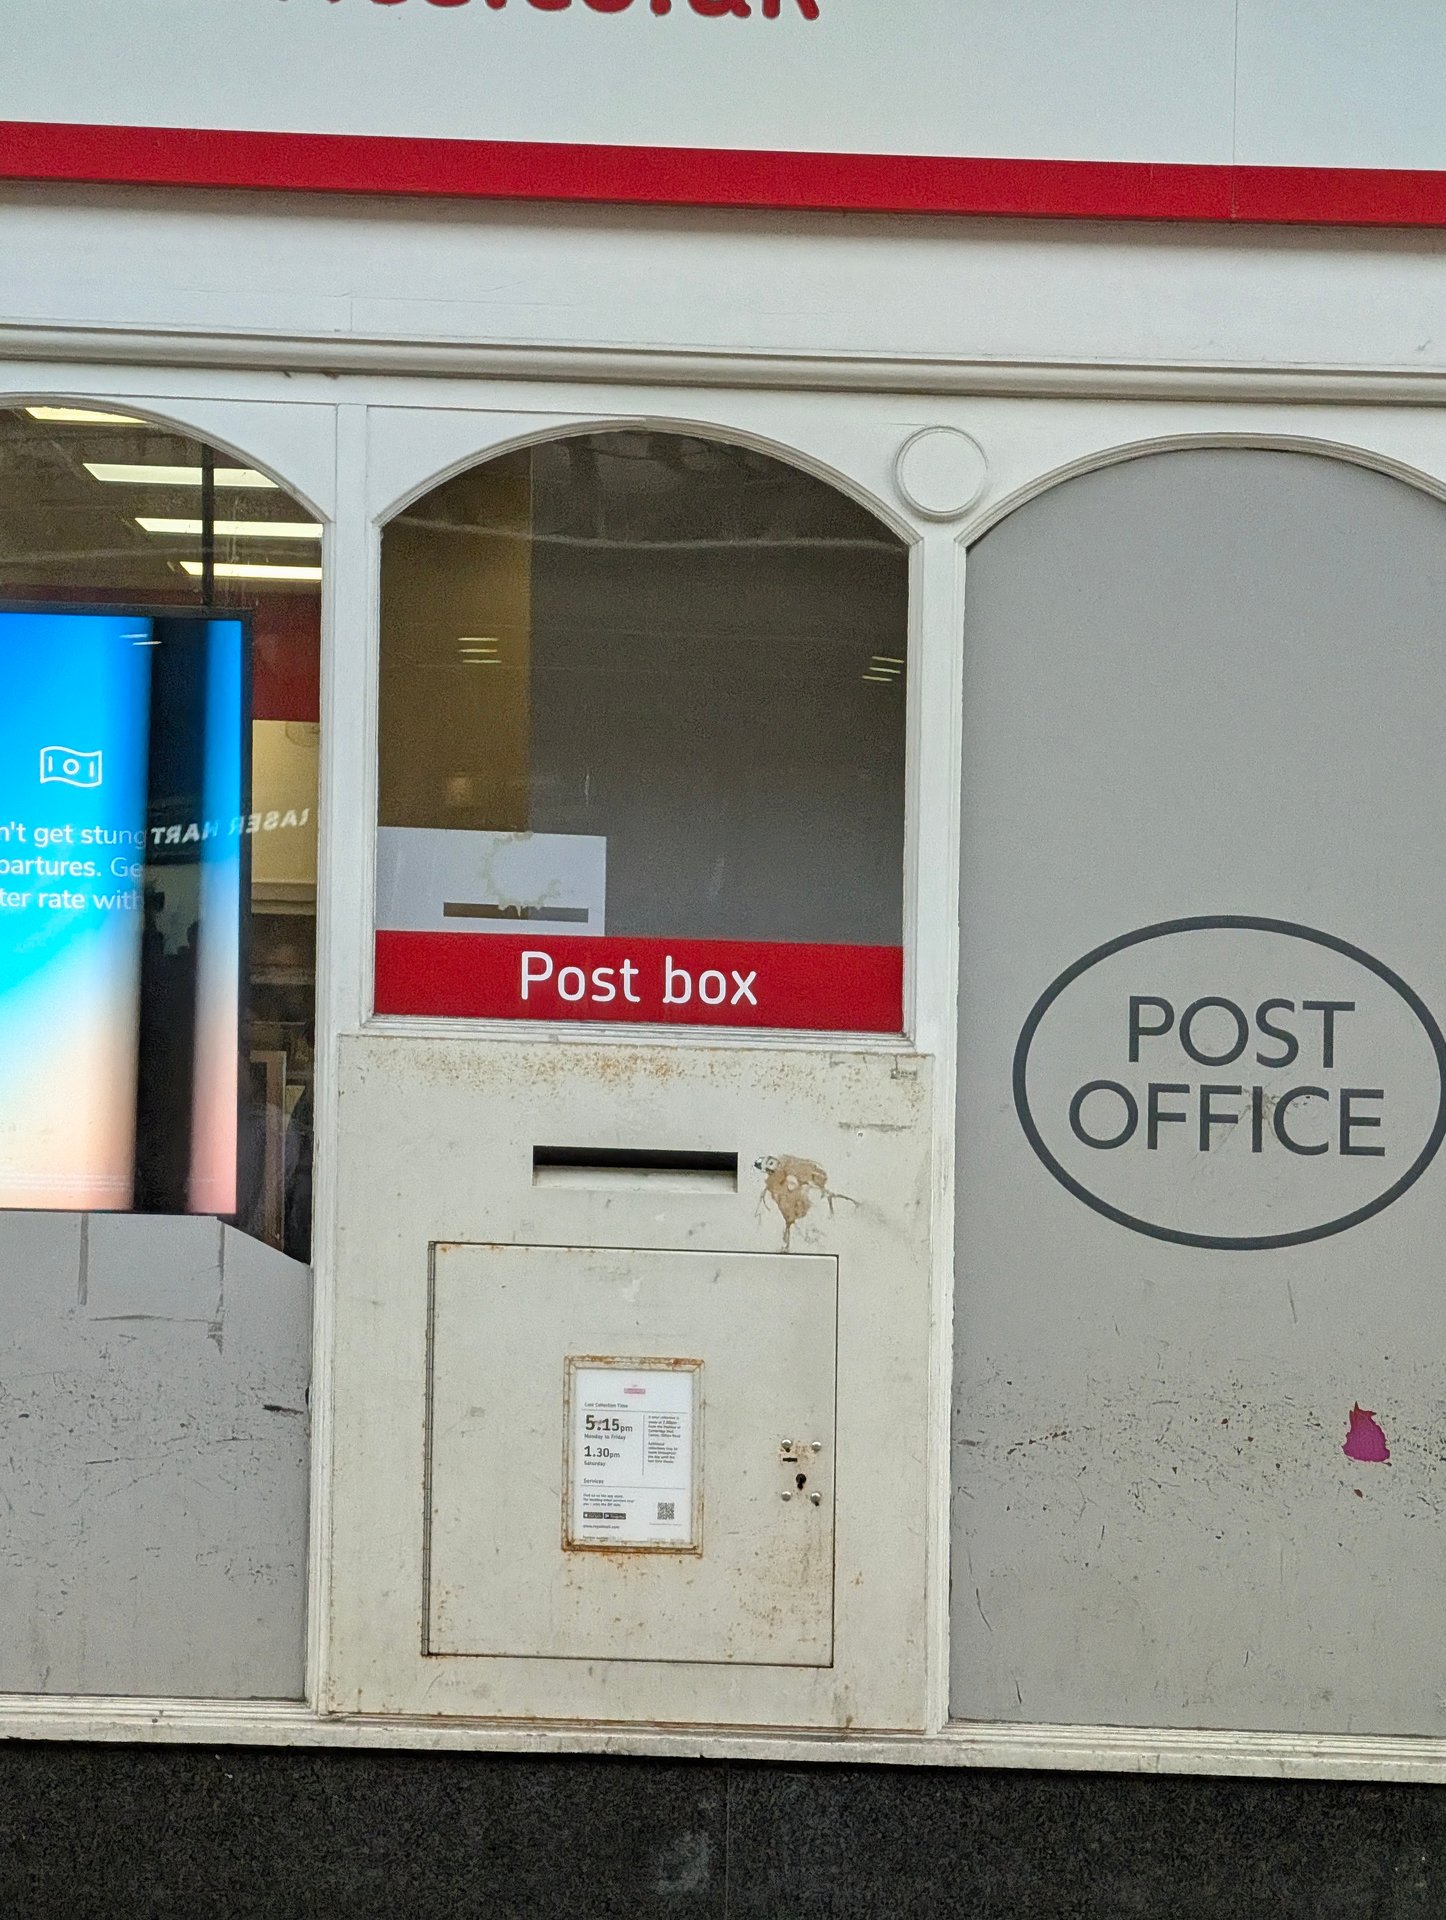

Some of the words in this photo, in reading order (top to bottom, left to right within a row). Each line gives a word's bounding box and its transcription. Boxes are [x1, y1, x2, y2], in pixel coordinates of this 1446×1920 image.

[34, 823, 73, 848] get
[81, 825, 147, 850] stung
[110, 856, 143, 878] Ge
[38, 889, 86, 910] rate
[93, 889, 144, 910] with
[521, 950, 641, 1003] Post
[662, 955, 758, 1005] box
[1128, 995, 1356, 1068] POST
[1069, 1080, 1386, 1157] OFFICE
[585, 1414, 633, 1433] 5.15pm
[611, 1433, 626, 1441] Friday
[584, 1445, 621, 1459] 1.30pm
